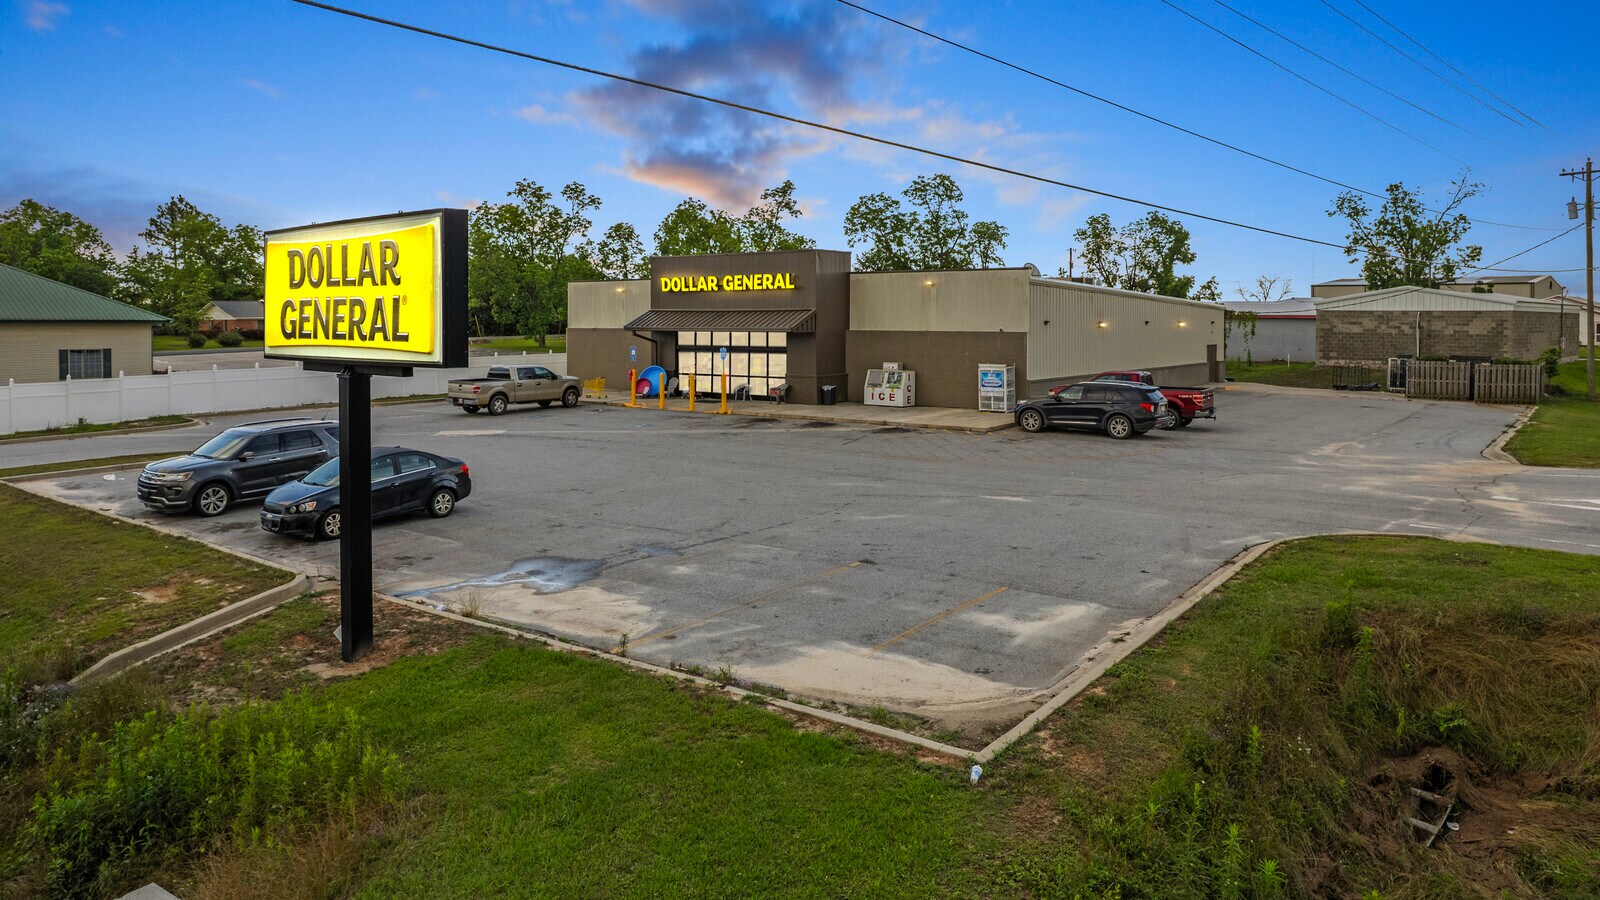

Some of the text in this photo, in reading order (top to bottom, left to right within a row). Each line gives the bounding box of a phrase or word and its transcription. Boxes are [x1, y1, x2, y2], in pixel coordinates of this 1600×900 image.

[287, 239, 401, 289] DOLLAR
[660, 273, 795, 292] DOLLAR GENERAL
[280, 295, 409, 342] GENERAL
[871, 392, 895, 402] ICE
